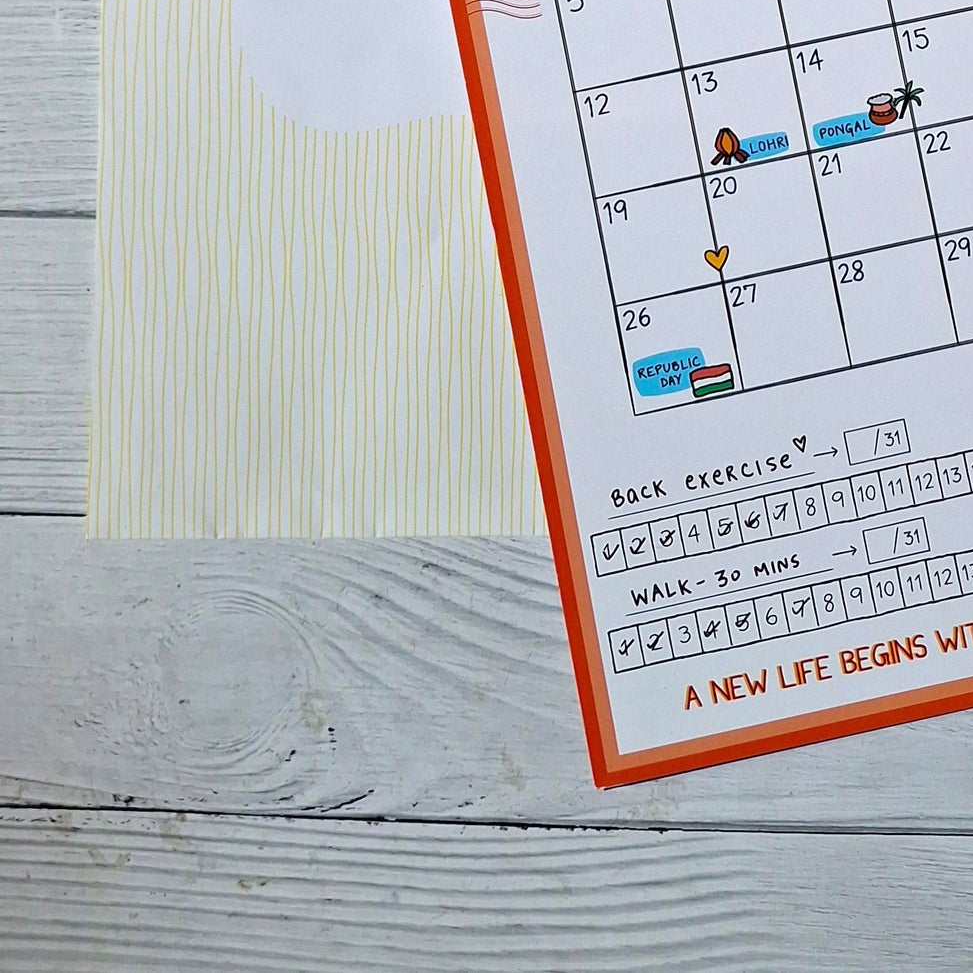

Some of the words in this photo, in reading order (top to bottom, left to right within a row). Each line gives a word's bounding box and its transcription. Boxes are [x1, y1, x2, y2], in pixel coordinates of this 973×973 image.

[902, 27, 930, 52] 15
[818, 119, 871, 139] PONGAL
[748, 134, 790, 156] LOHRI
[709, 176, 738, 199] 20
[837, 260, 865, 284] 28
[636, 356, 701, 380] REPUBLIC
[660, 372, 682, 388] DAY
[805, 497, 817, 517] 8
[684, 684, 703, 711] A
[709, 668, 768, 705] NEW
[777, 654, 832, 690] LIFE
[839, 634, 928, 676] BEGINS
